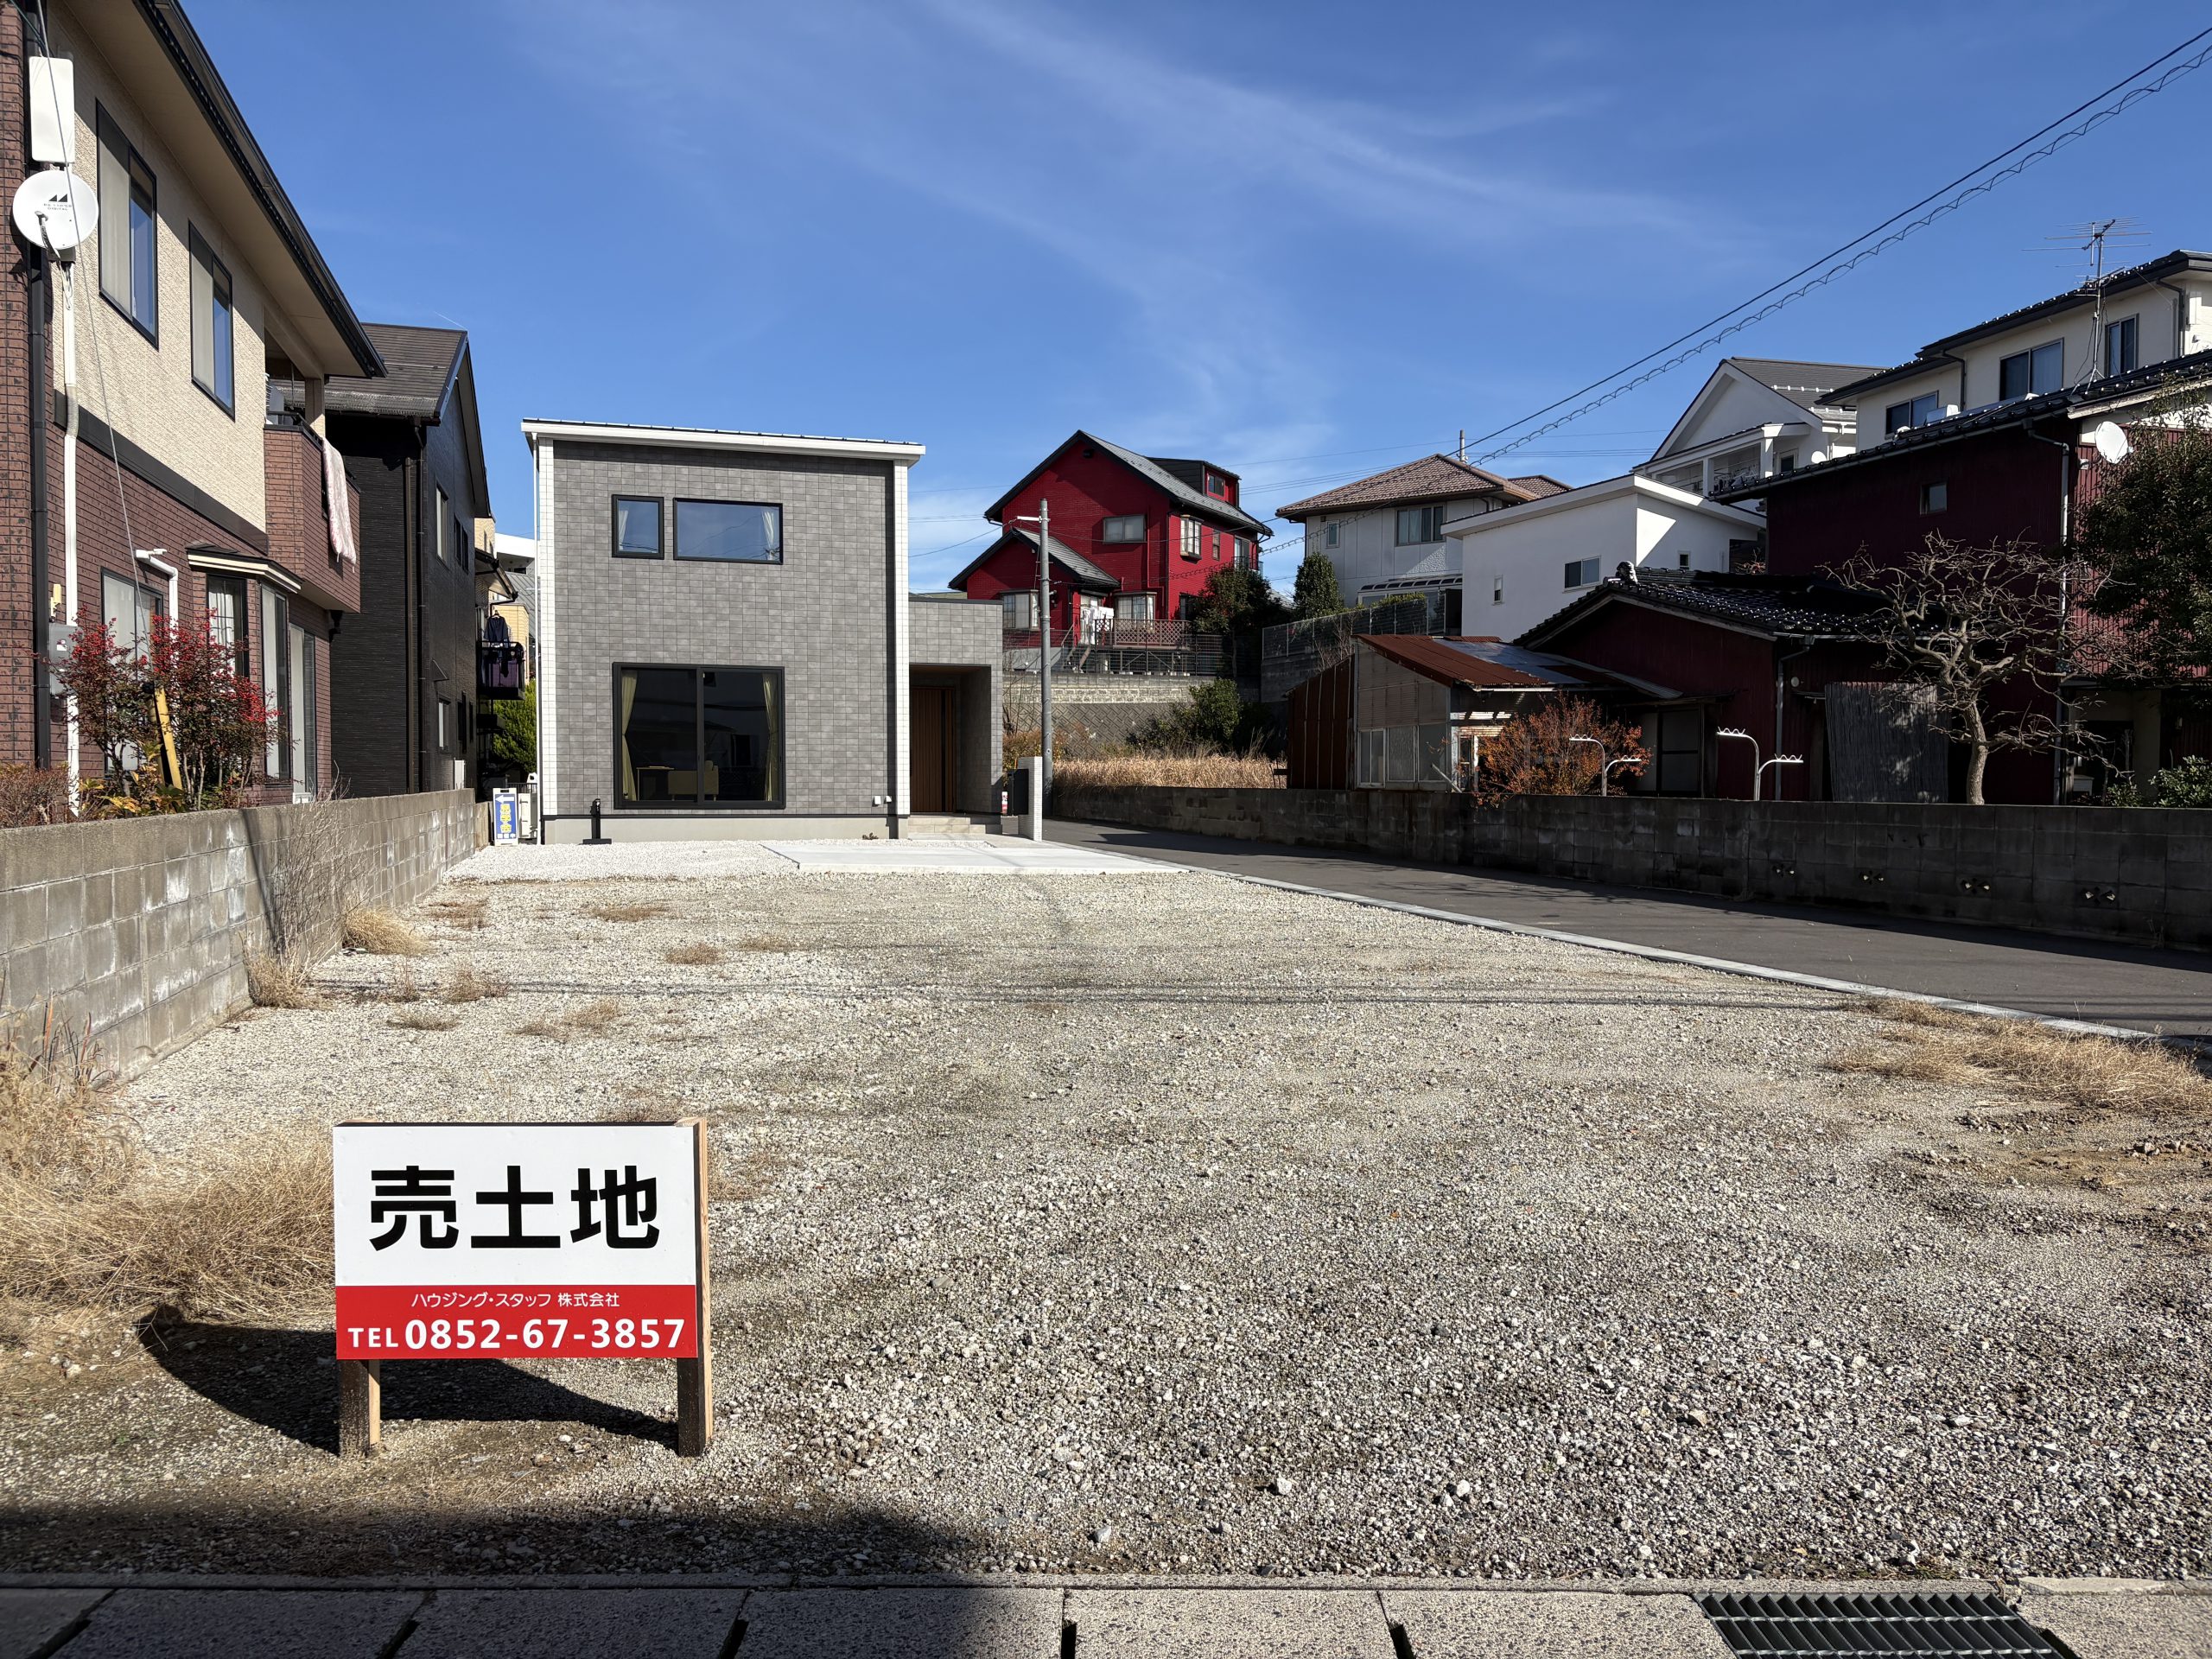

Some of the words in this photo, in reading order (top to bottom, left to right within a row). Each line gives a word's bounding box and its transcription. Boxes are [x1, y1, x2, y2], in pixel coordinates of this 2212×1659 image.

[370, 1165, 660, 1252] 売土地
[411, 1291, 551, 1308] ハウジング・スタッフ
[557, 1291, 620, 1308] 株式会社
[347, 1327, 399, 1349] TEL
[404, 1318, 685, 1350] 0852-67-3857
